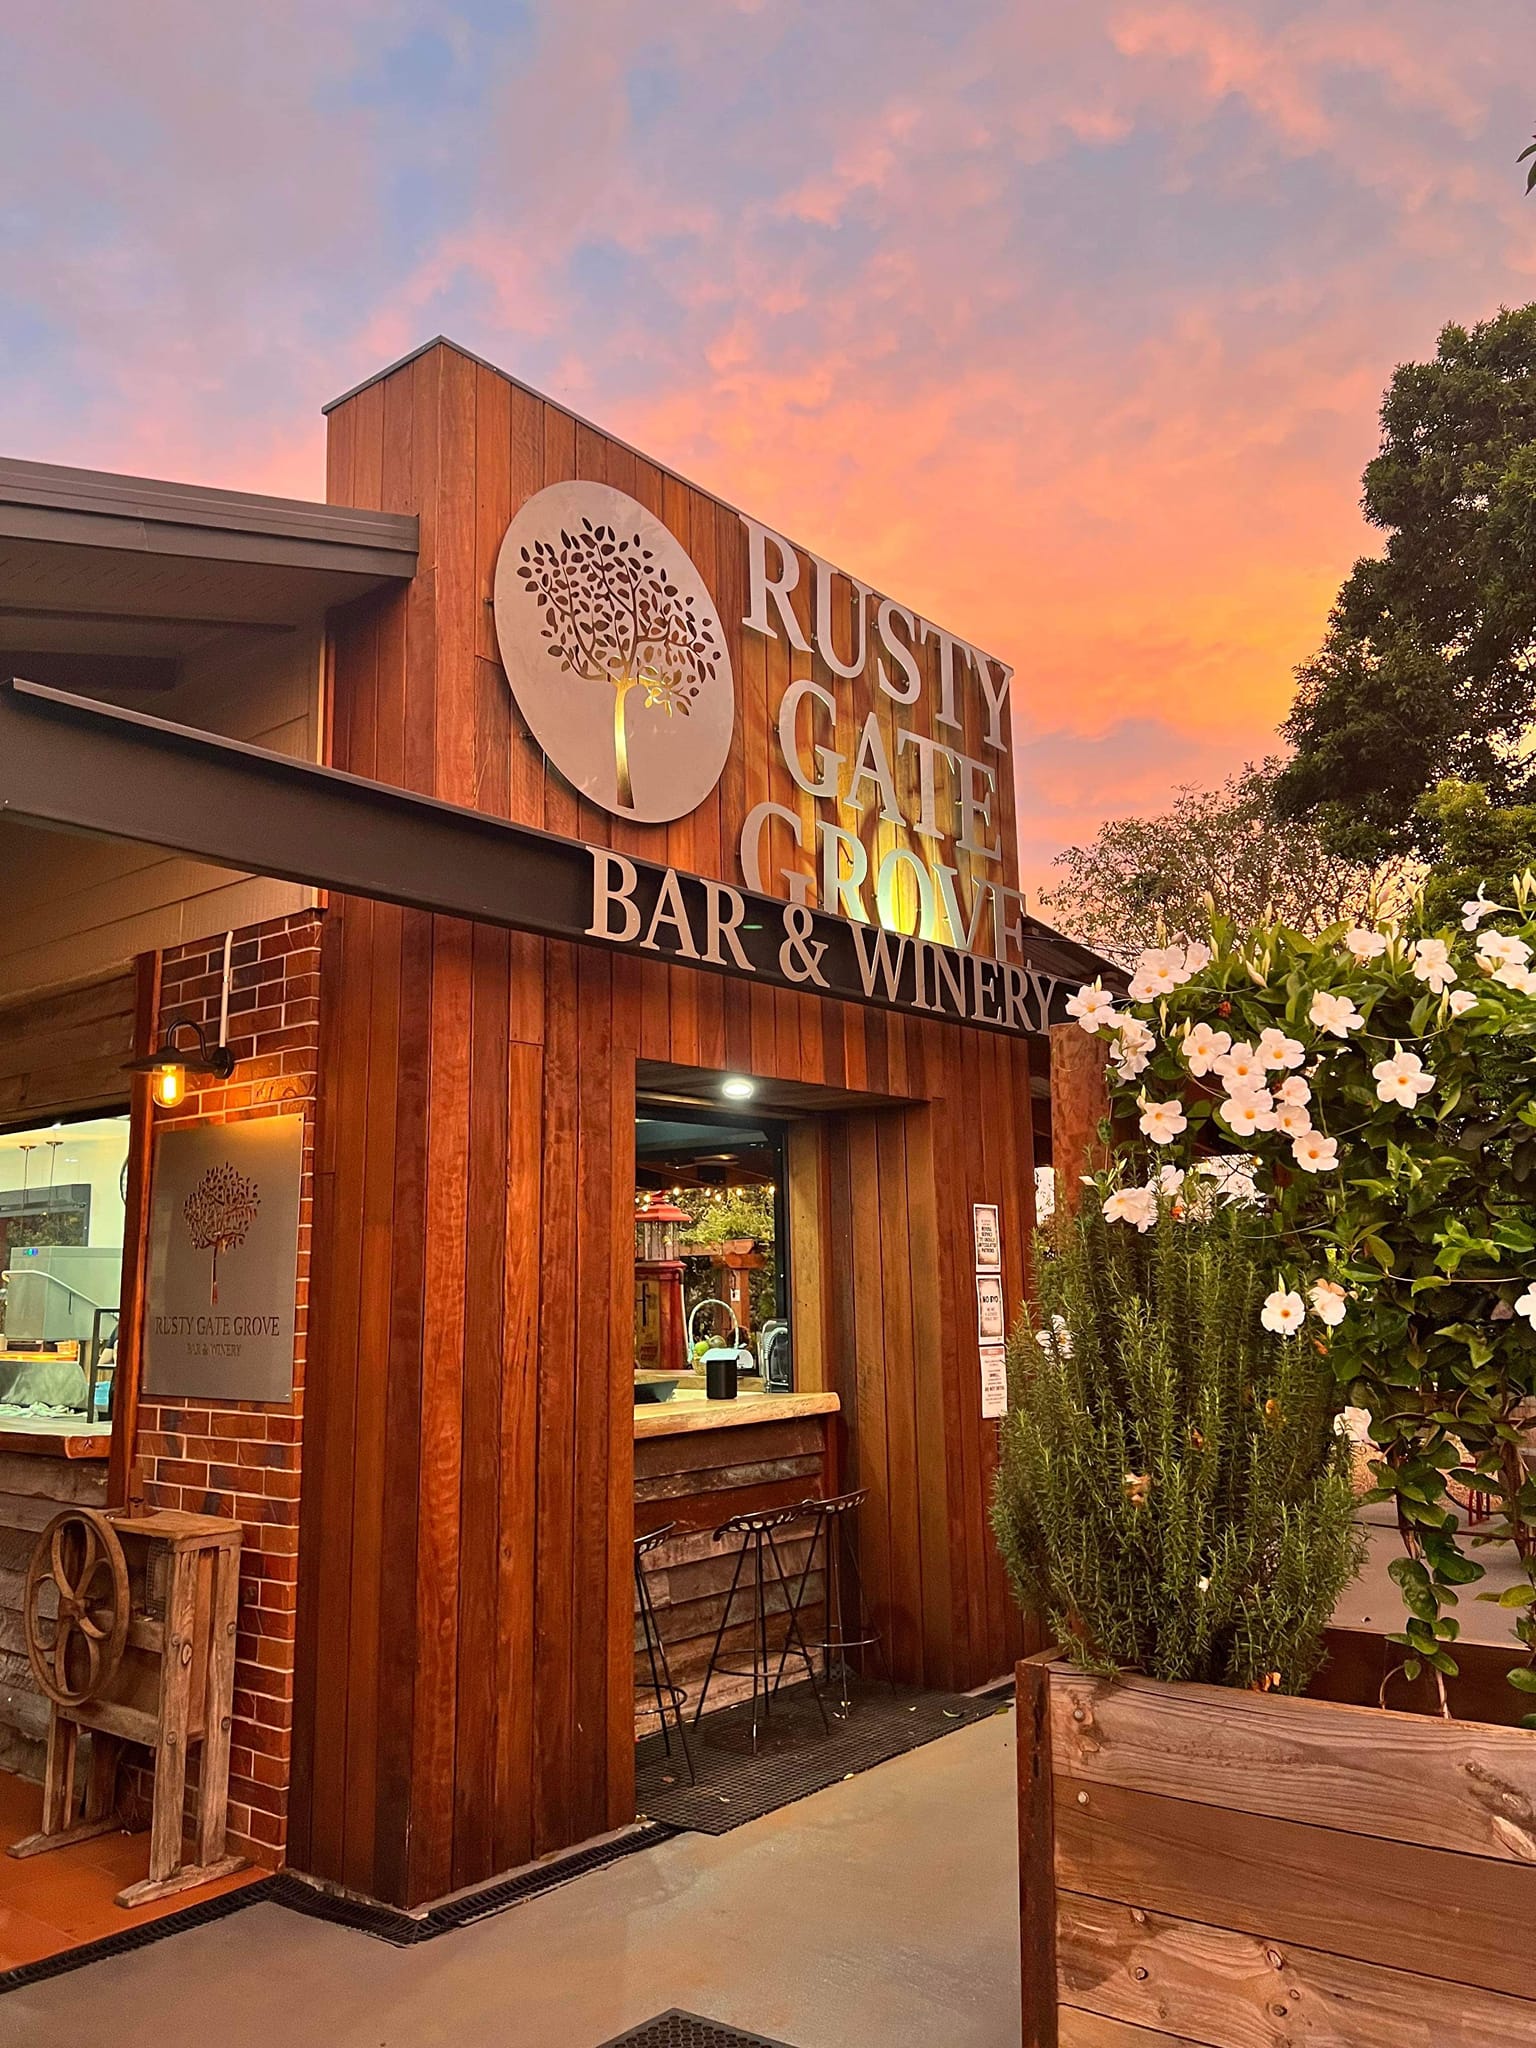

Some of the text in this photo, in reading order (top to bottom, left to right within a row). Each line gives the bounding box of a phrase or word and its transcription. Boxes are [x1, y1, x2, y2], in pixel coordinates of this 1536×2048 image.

[738, 513, 1015, 753] RUSTY
[779, 679, 1001, 861] GATE
[584, 845, 1058, 1036] BAR & WINERY
[740, 802, 1028, 965] GROVE
[155, 1316, 280, 1336] RUSTY GATE GROVE
[210, 1344, 241, 1357] WINERY
